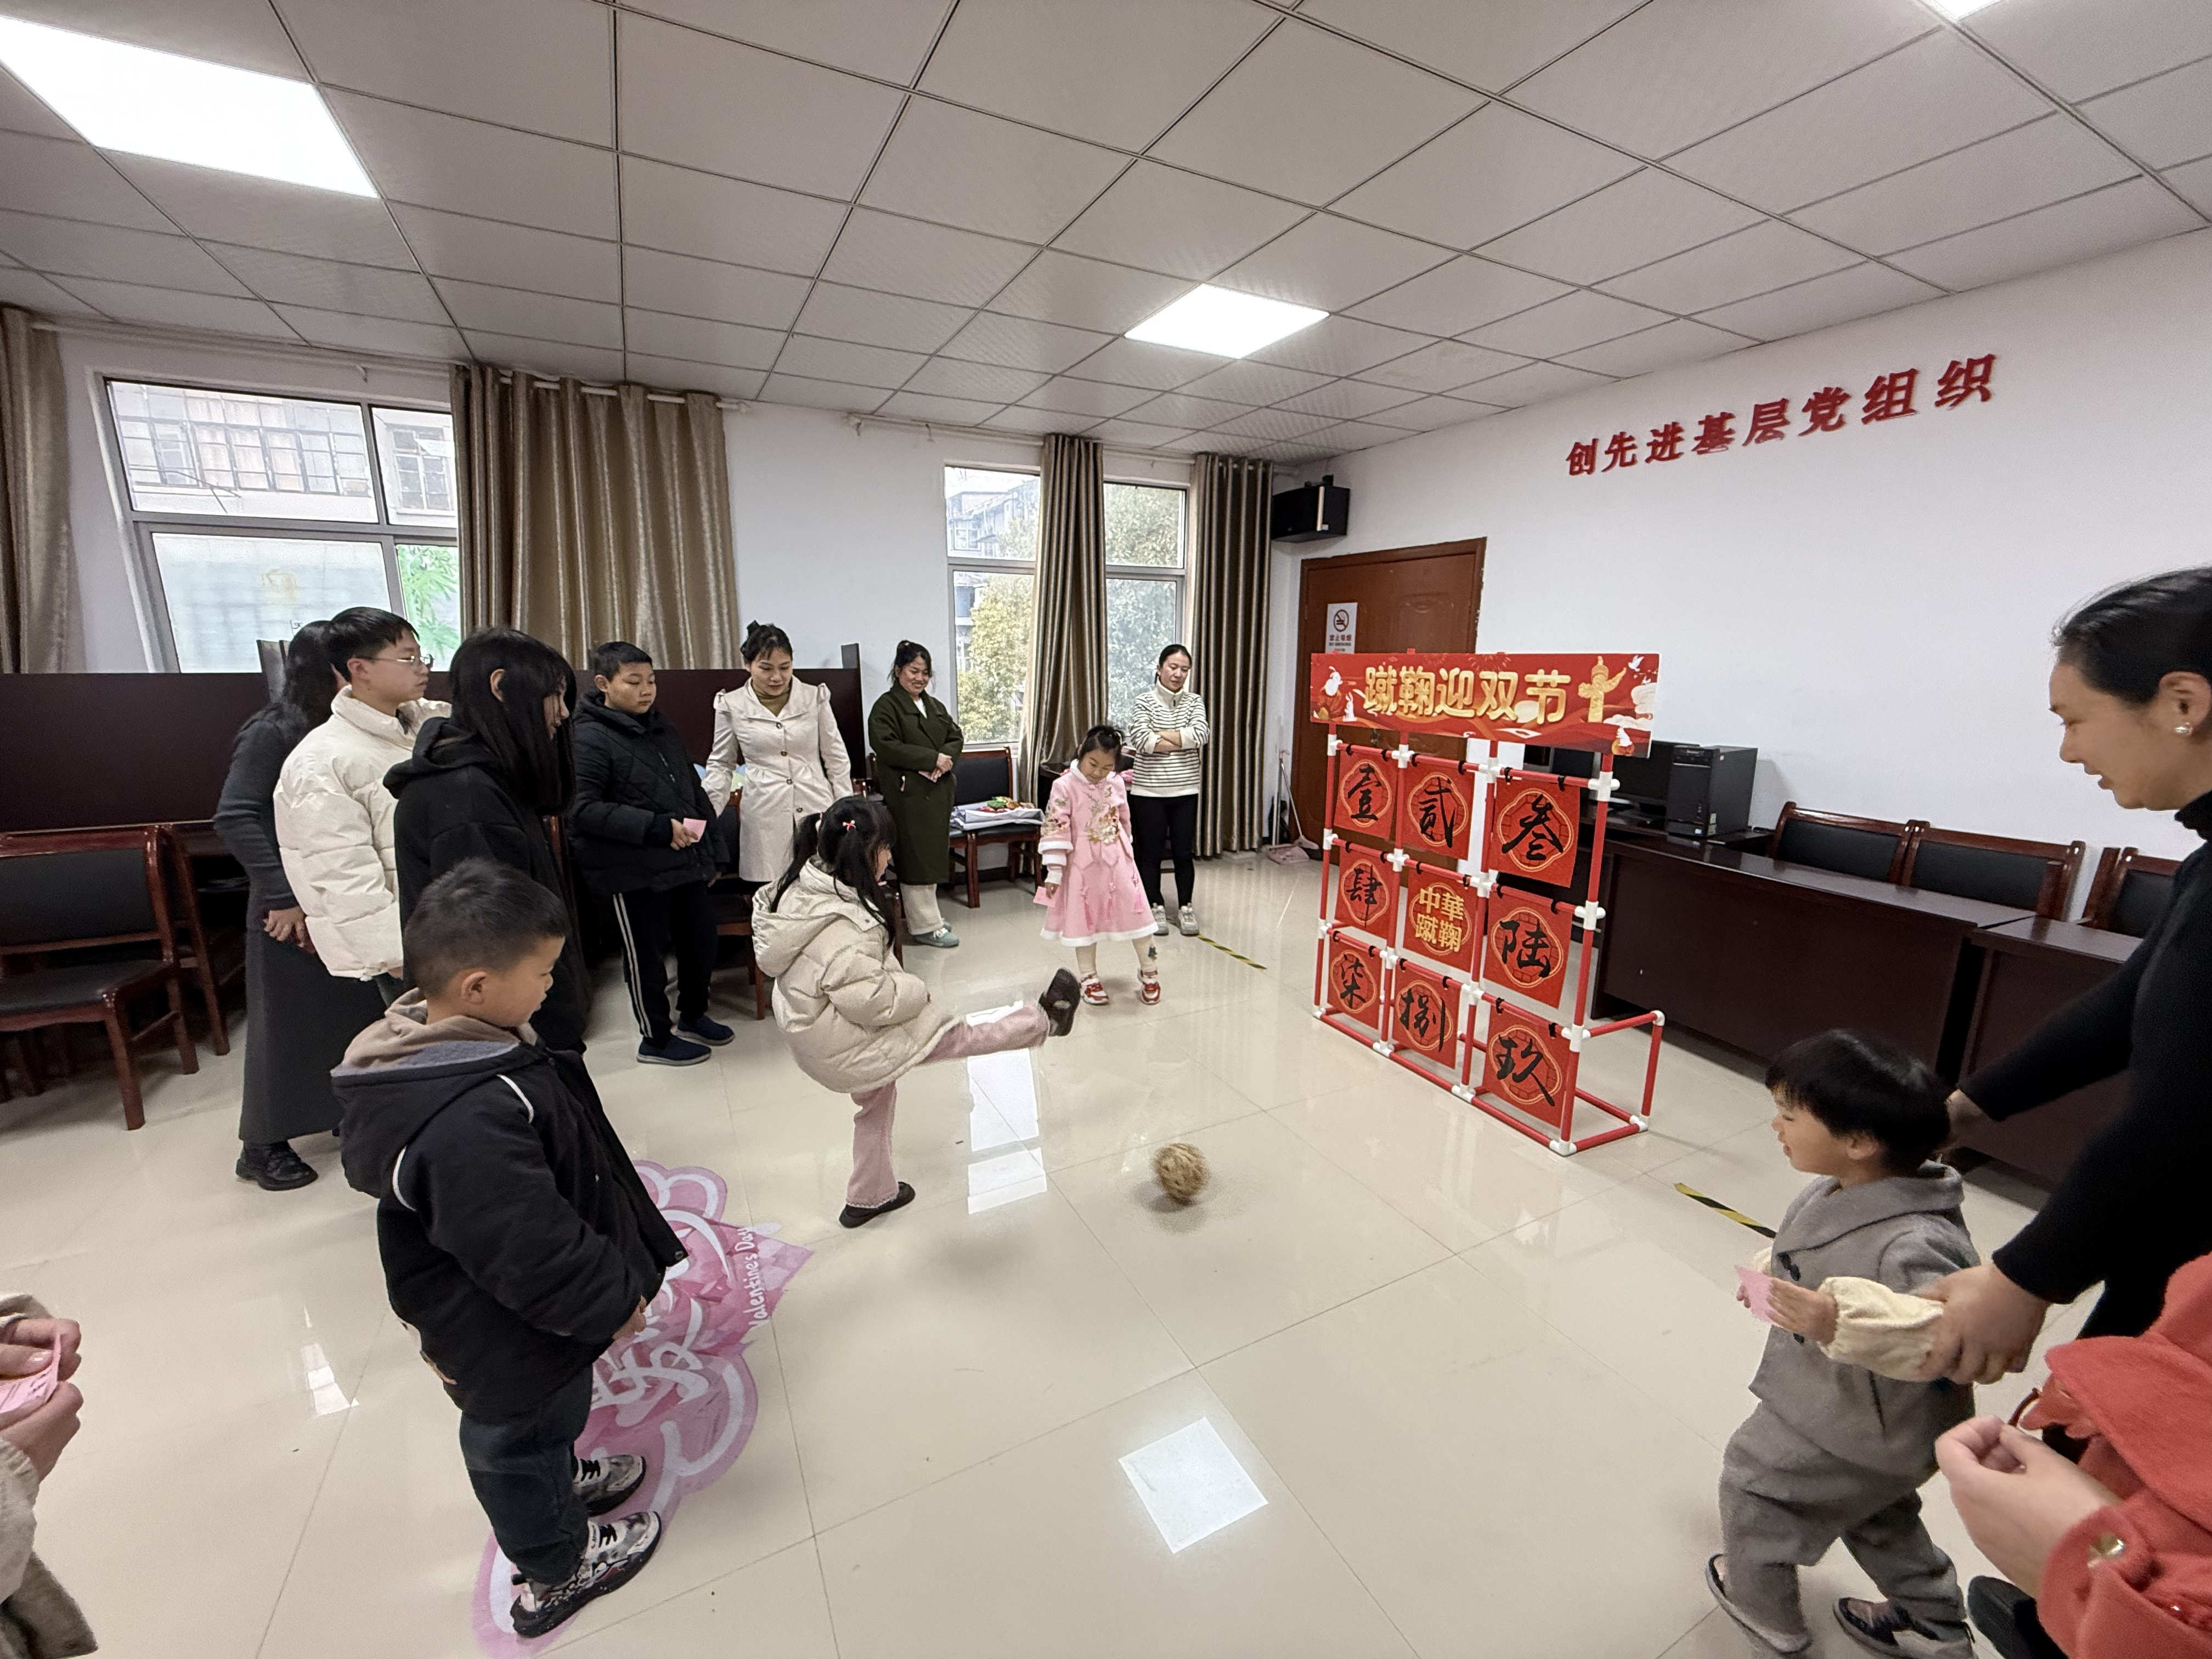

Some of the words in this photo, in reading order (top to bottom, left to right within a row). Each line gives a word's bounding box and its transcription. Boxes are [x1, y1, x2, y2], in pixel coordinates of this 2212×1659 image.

[1566, 354, 1996, 476] 创先进基层党组织
[1363, 665, 1571, 724] 蹴鞠迎双节
[1348, 764, 1379, 821] 壹
[1502, 794, 1564, 861] 叁
[1346, 865, 1383, 928] 肆
[1419, 887, 1464, 921] 中華
[1415, 913, 1462, 952] 蹴鞠
[1340, 953, 1366, 1008] 柒
[1400, 988, 1446, 1052] 捌
[1496, 1034, 1555, 1107] 玖
[735, 1227, 755, 1252] Day
